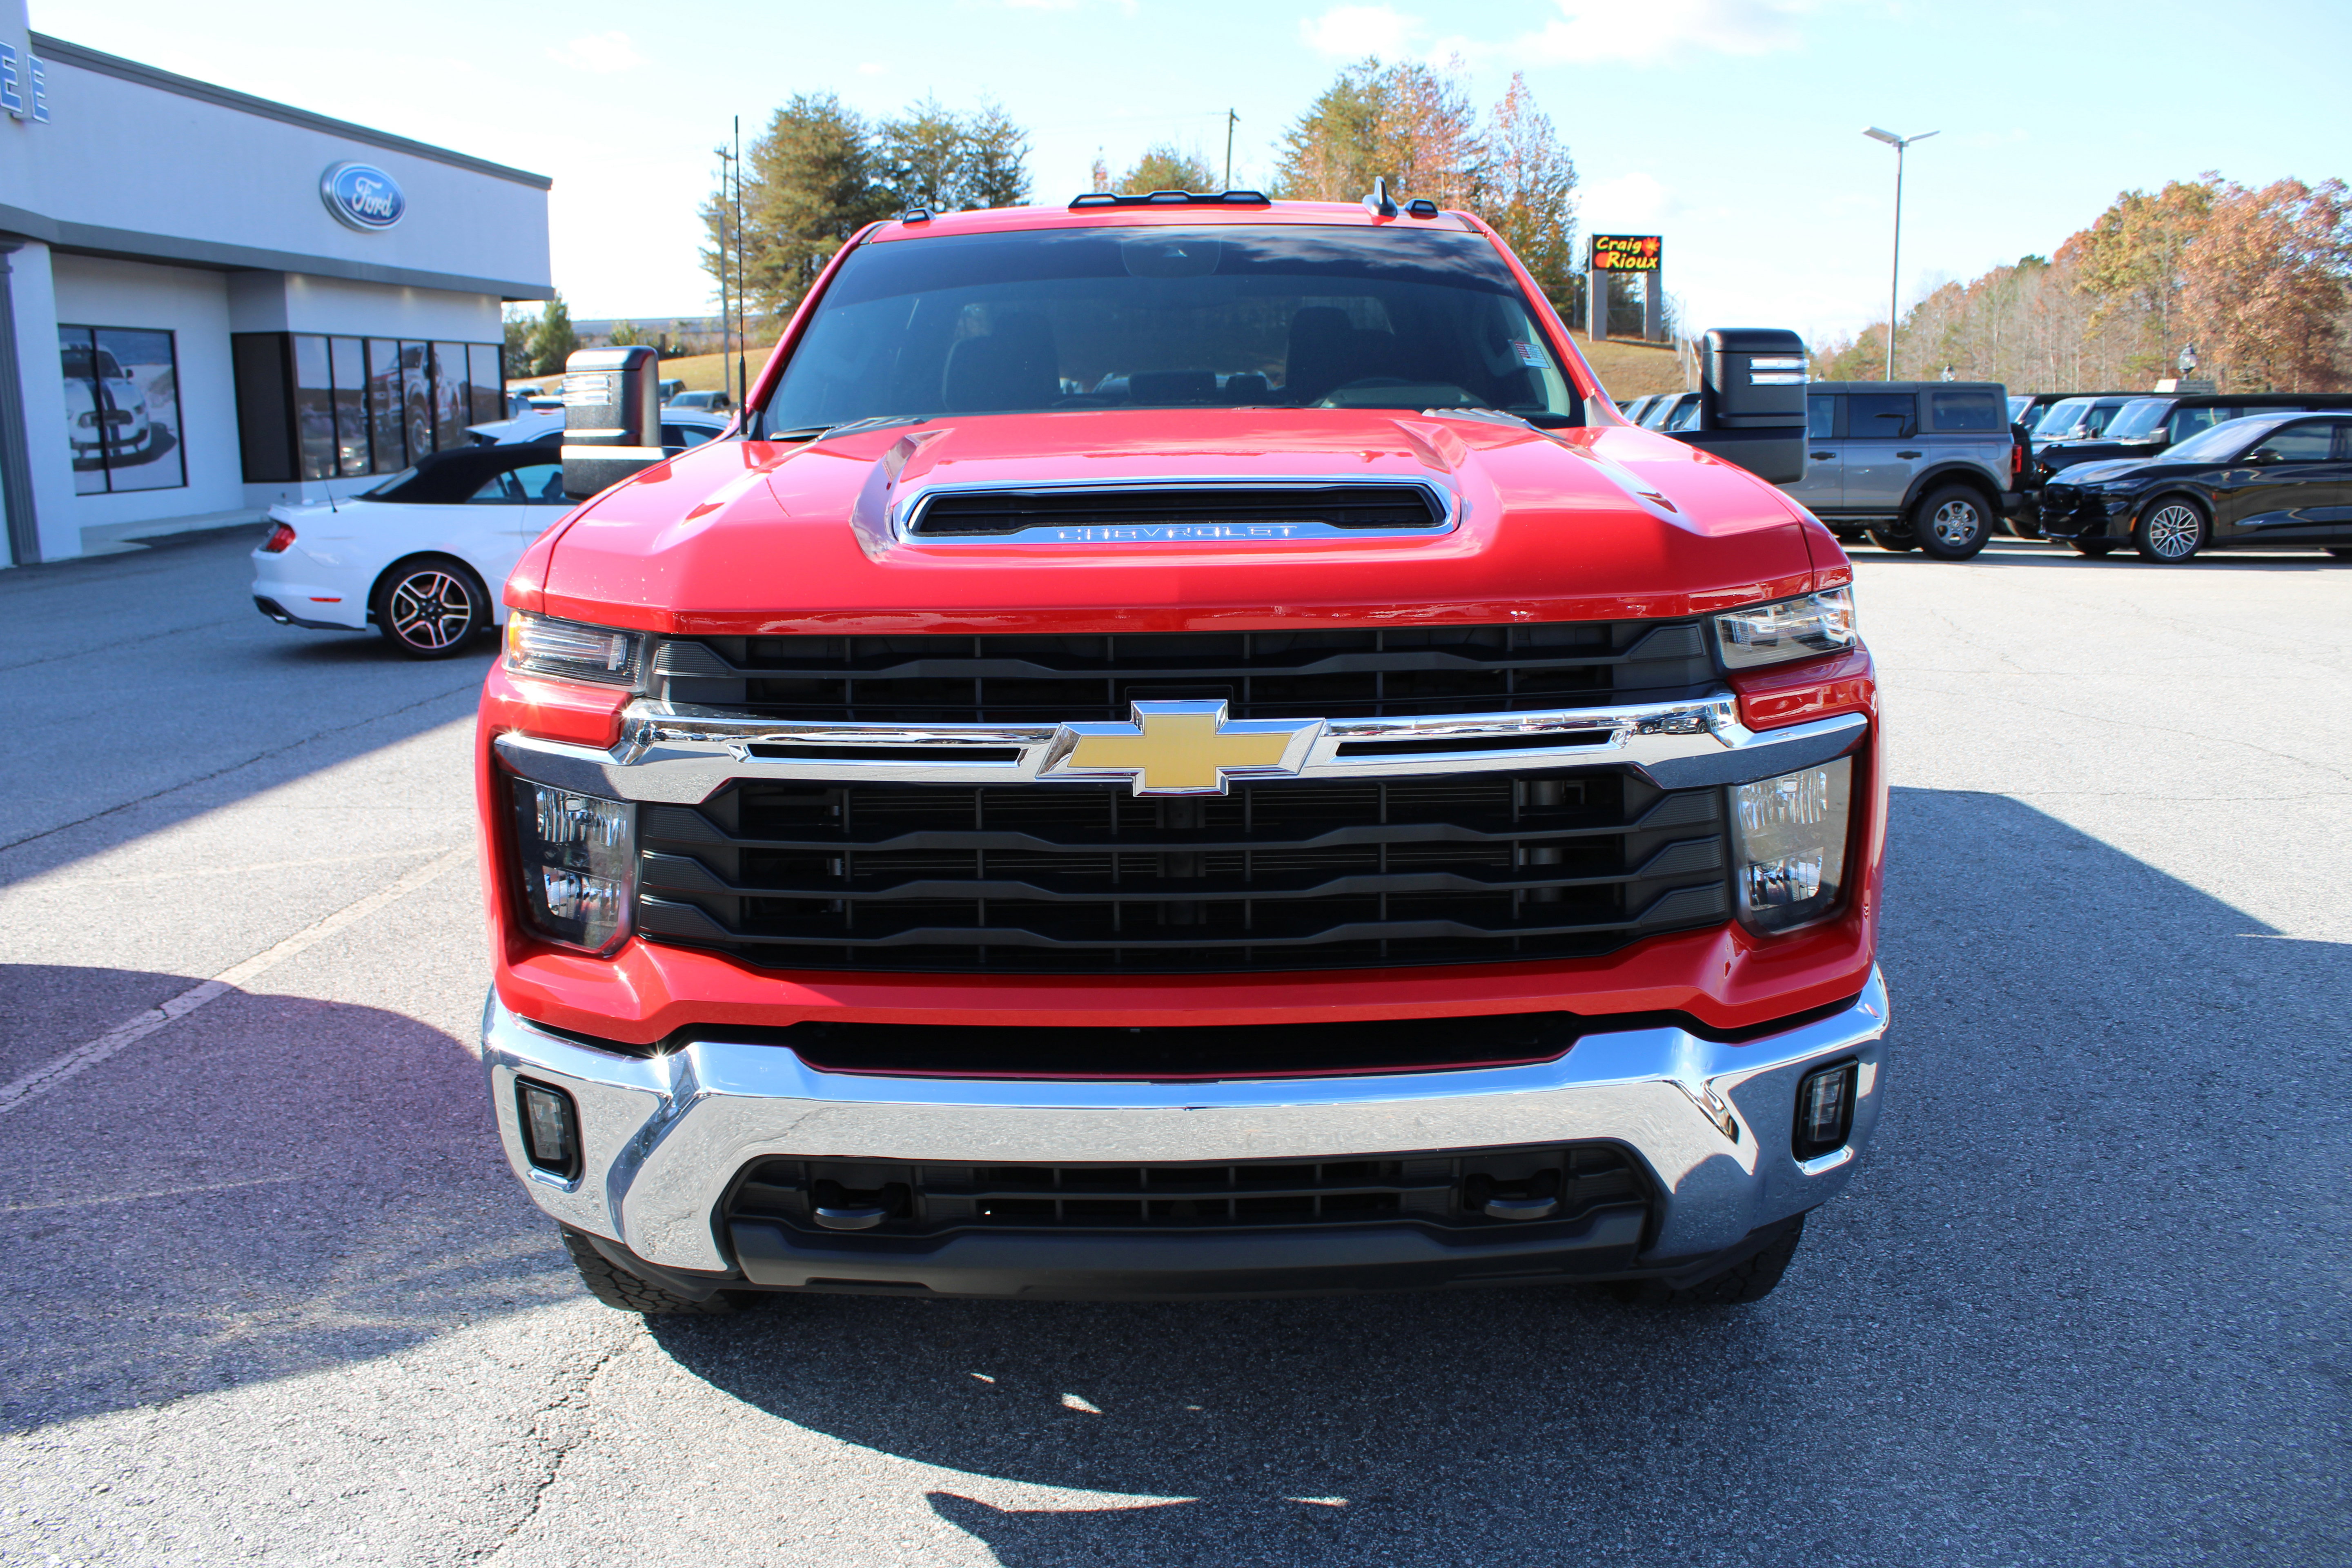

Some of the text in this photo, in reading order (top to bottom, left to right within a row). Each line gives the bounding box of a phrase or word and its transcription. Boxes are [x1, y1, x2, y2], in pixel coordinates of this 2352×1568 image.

[352, 176, 393, 218] Ford
[1596, 236, 1642, 254] Craig
[1606, 251, 1658, 269] Rioux
[1057, 526, 1297, 540] CHEVROLET
